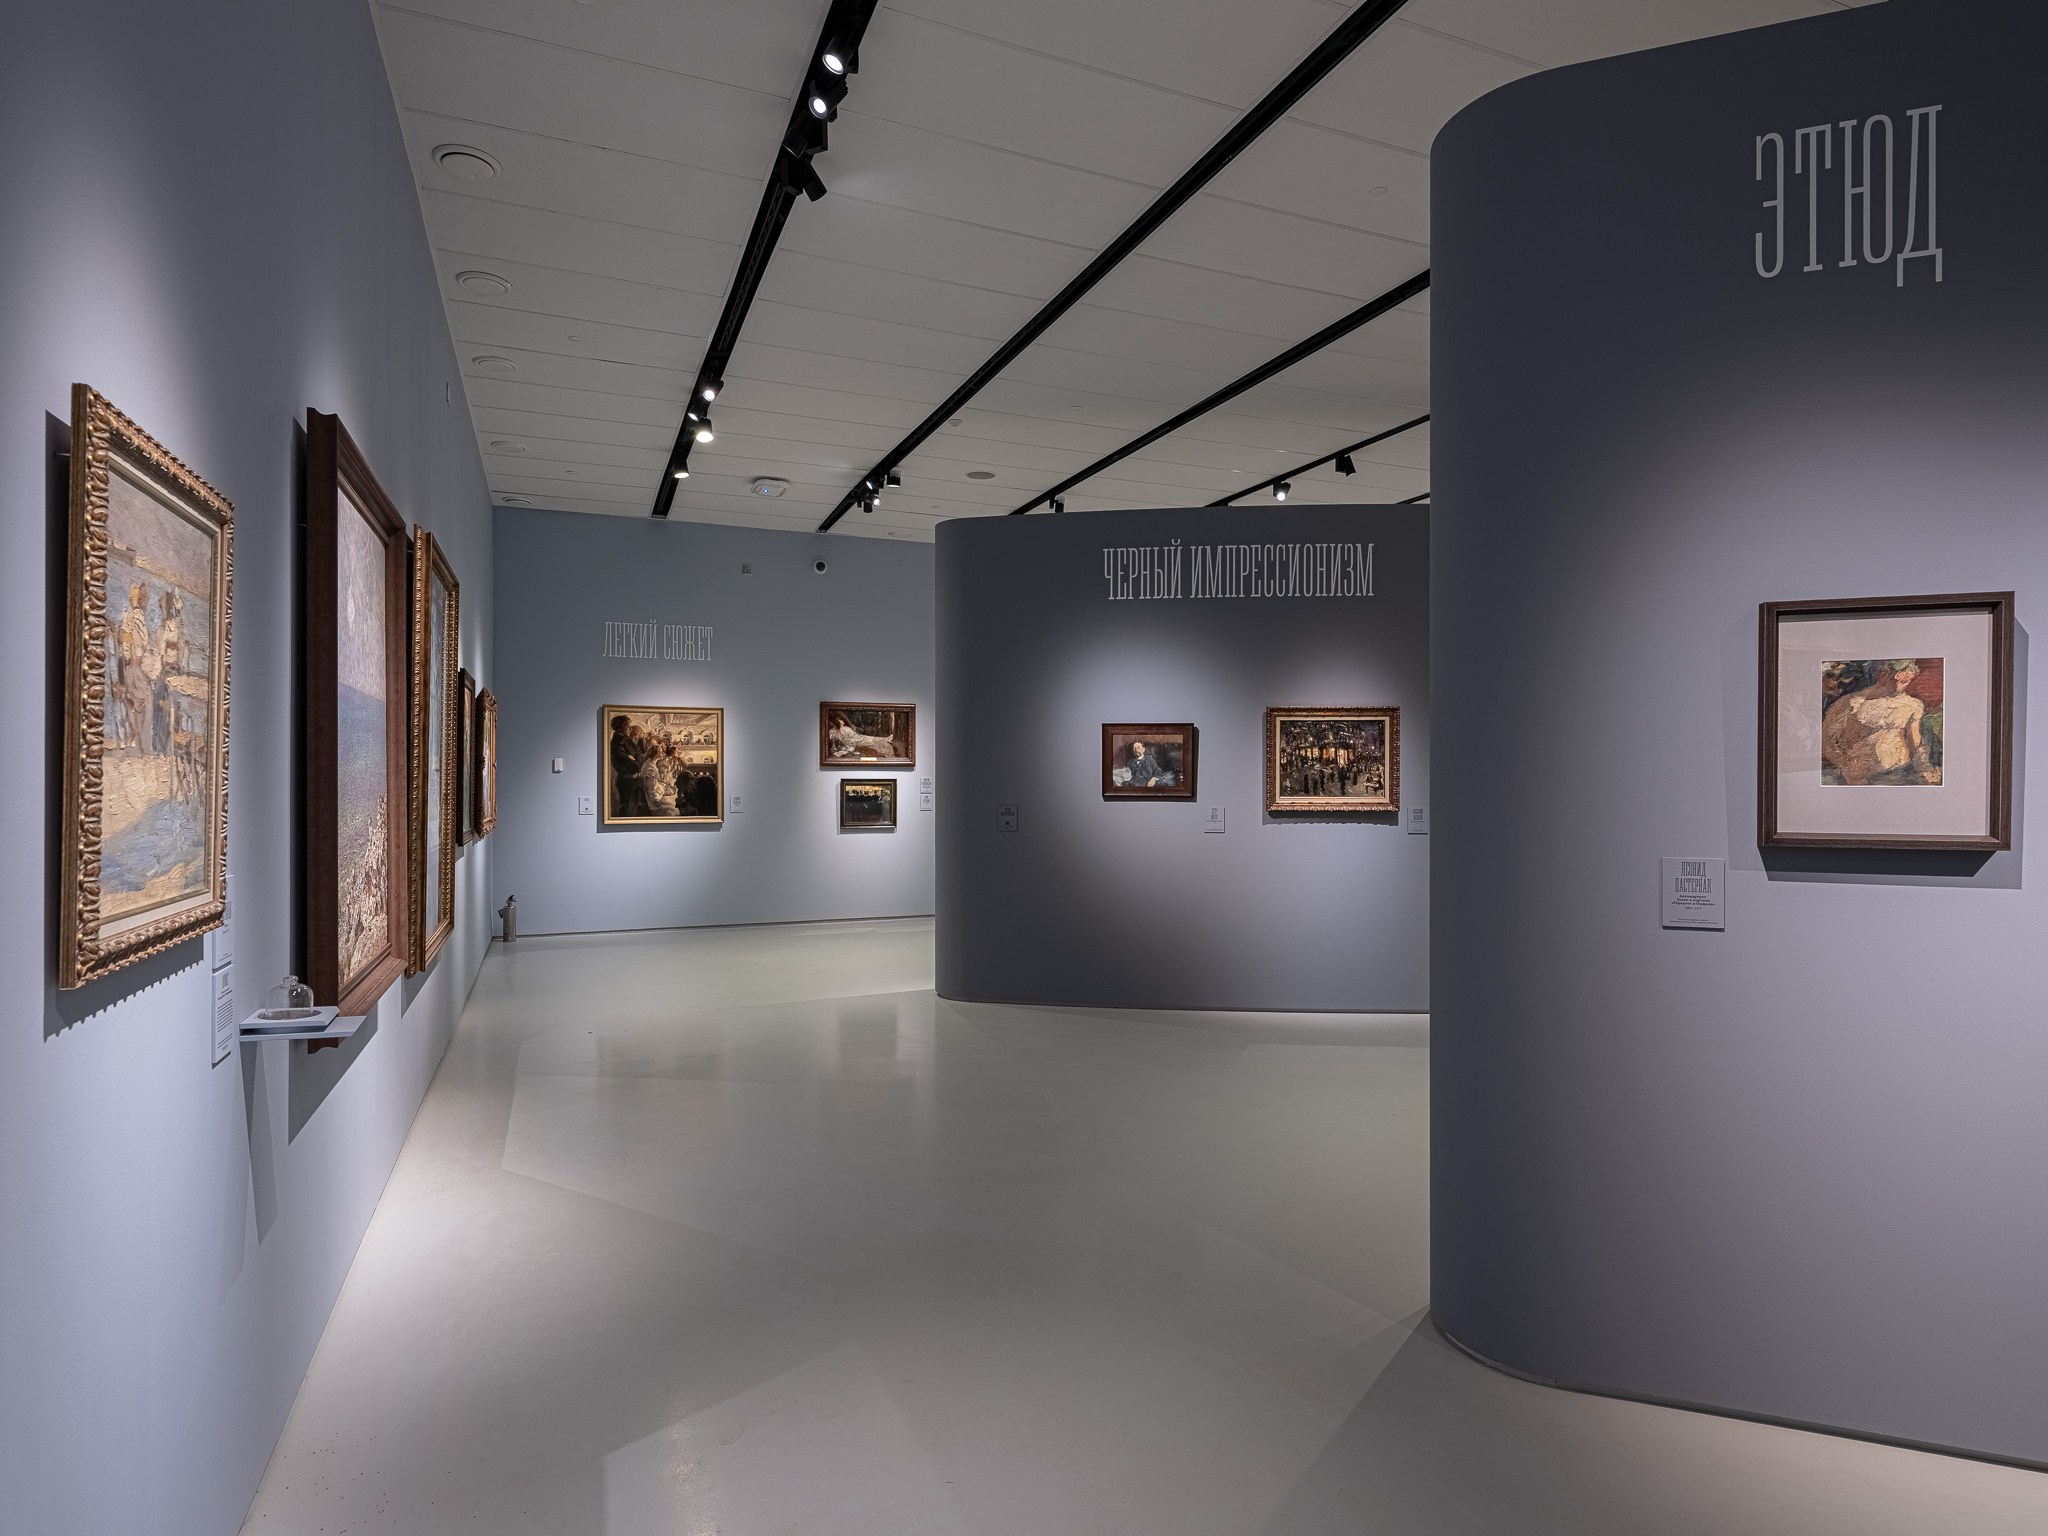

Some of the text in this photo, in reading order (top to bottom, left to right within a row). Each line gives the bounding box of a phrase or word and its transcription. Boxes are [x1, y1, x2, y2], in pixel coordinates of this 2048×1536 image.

[1755, 104, 1943, 288] ЭТЮД
[1102, 538, 1375, 600] ЧЕРНЫЙ ИМПРЕССИОНИЗМ
[602, 618, 713, 661] ЛЕГКИЙ СЮЖЕТ
[1675, 878, 1712, 893] ПАСТЕРНАК
[1681, 862, 1706, 878] ЛЕОНИД
